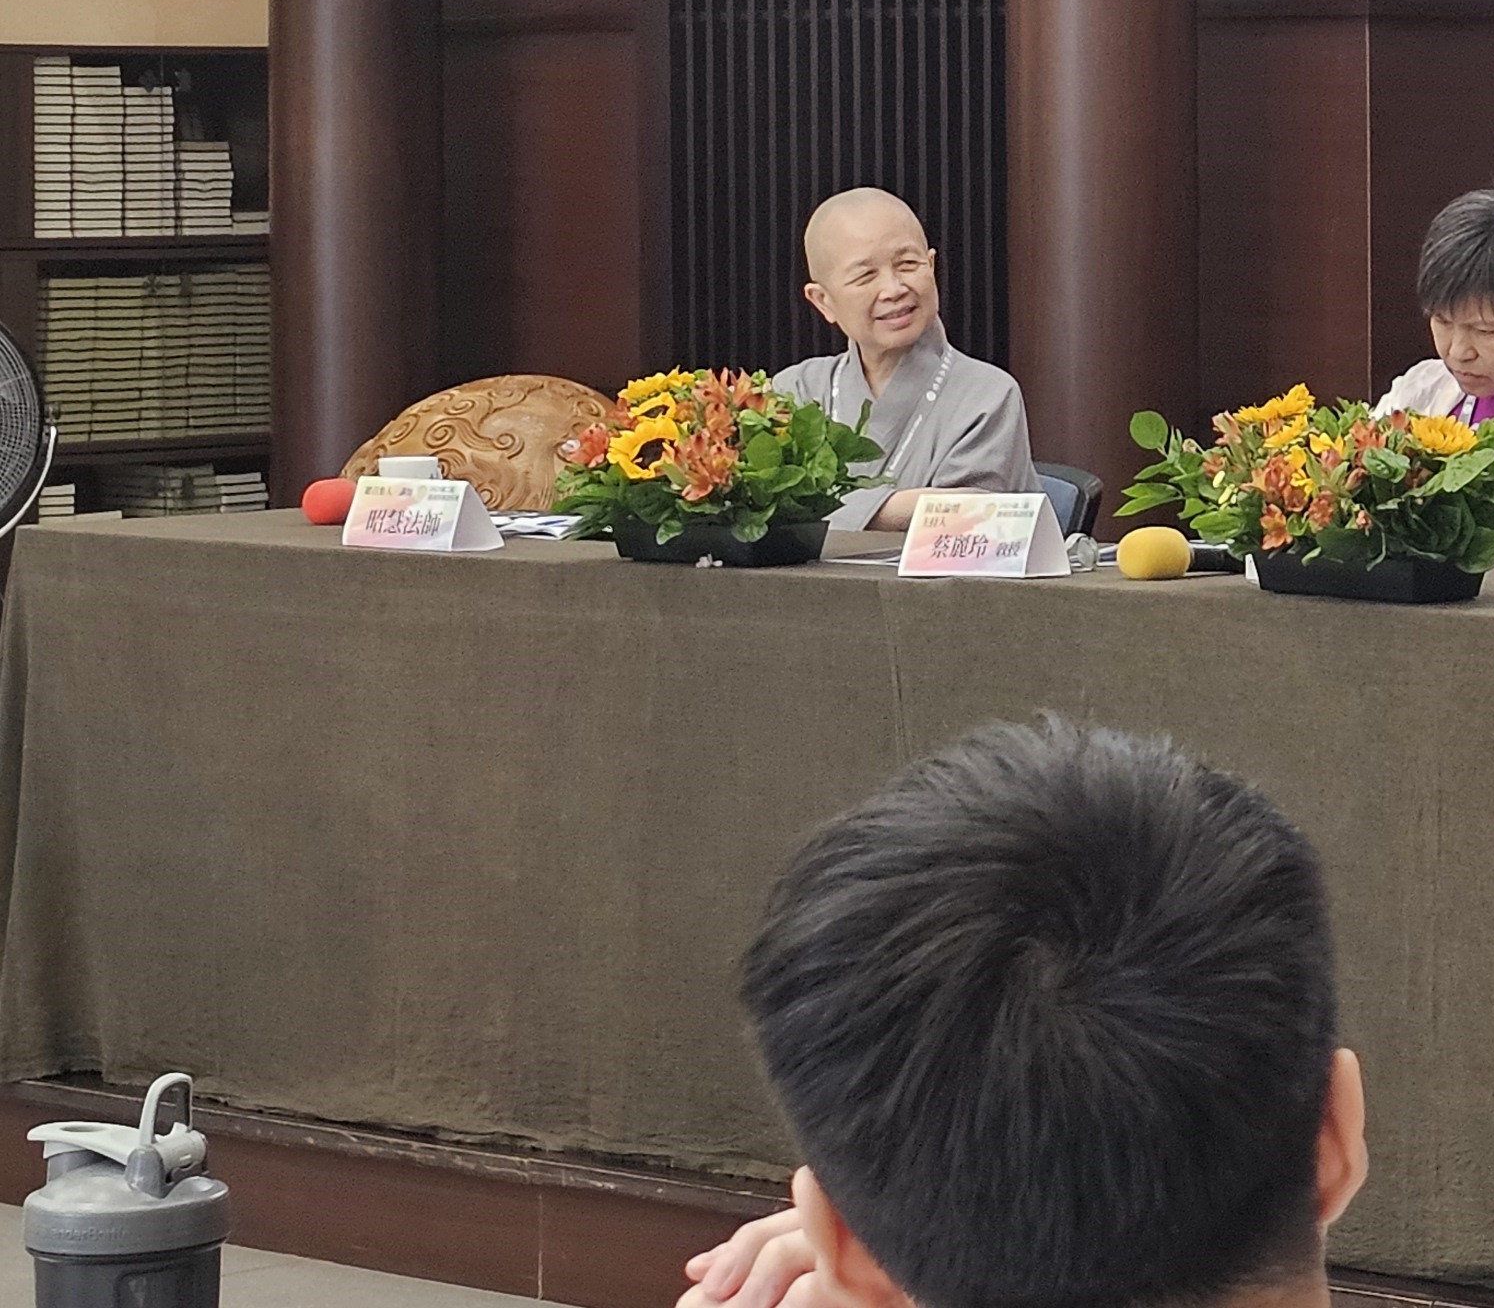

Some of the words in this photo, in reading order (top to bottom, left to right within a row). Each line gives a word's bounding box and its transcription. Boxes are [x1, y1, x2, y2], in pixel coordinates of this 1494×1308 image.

[365, 509, 443, 536] 昭慧法師
[932, 534, 989, 558] 蔡麗玲
